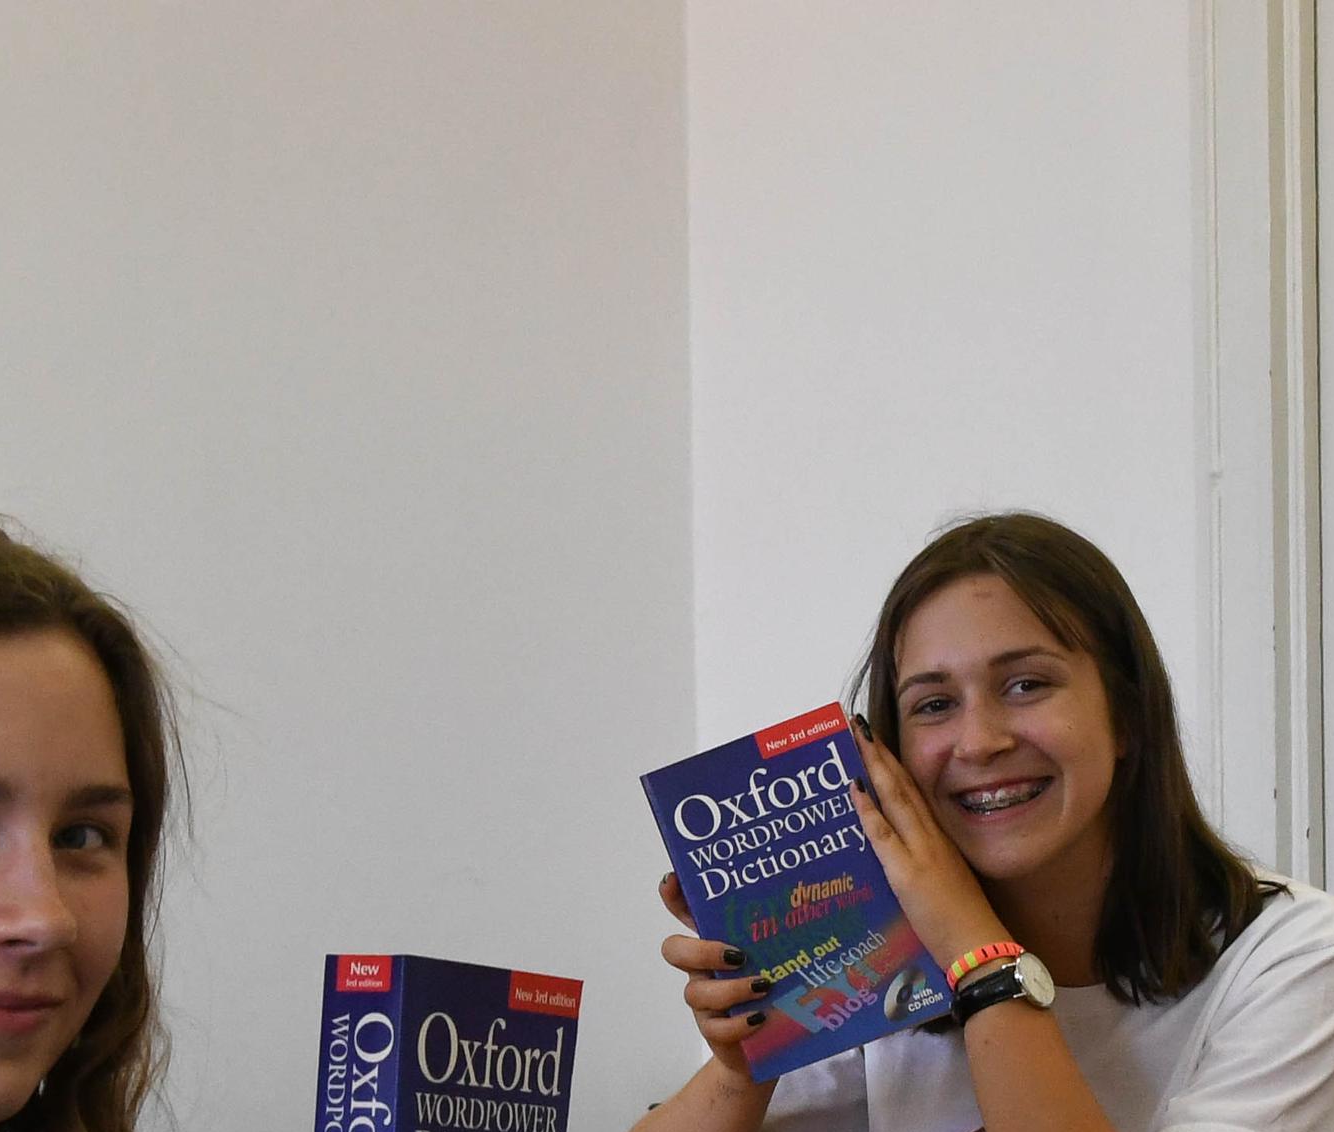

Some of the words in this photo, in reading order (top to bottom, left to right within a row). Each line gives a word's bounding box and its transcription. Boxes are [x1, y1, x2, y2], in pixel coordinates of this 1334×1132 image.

[766, 737, 788, 752] New
[789, 730, 805, 744] 3rd
[806, 717, 840, 739] edition
[673, 741, 854, 842] Oxford
[697, 824, 866, 901] Dictionary
[790, 872, 854, 908] dynamic
[350, 962, 380, 976] New
[760, 950, 812, 984] tand
[814, 936, 841, 957] out
[795, 957, 842, 988] life
[839, 929, 887, 967] coach
[345, 979, 357, 988] 3rd
[358, 979, 383, 988] edition
[515, 988, 532, 1001] New
[534, 990, 548, 1005] 3rd
[548, 993, 576, 1009] edition
[913, 987, 933, 1000] with
[818, 987, 878, 1032] blog
[908, 992, 943, 1013] CD-ROM
[417, 1011, 564, 1096] Oxford
